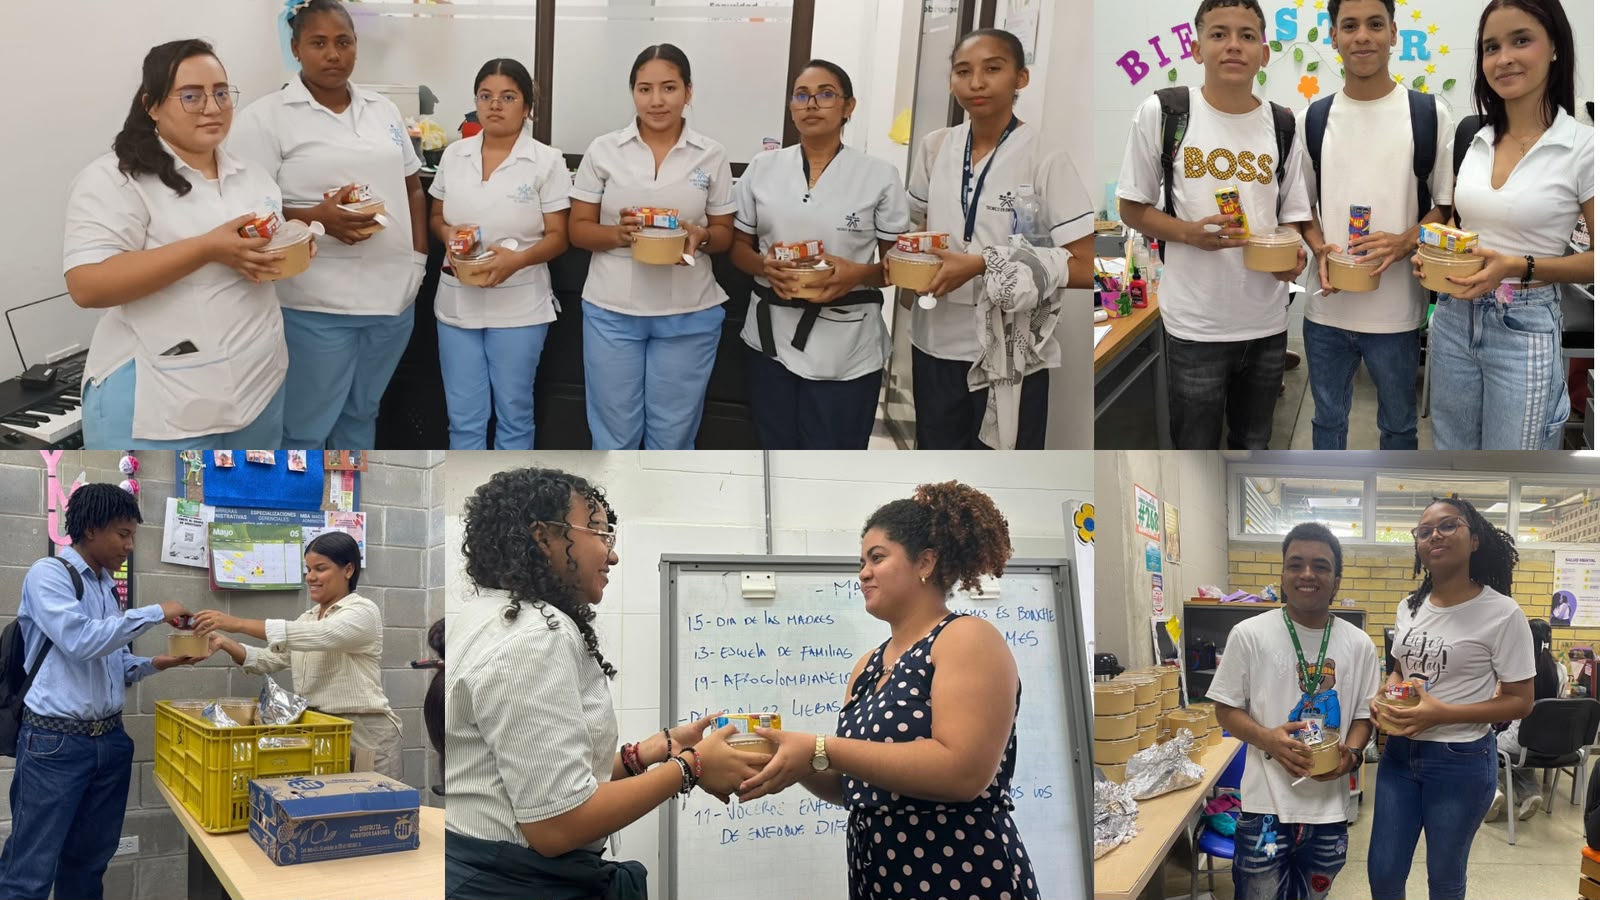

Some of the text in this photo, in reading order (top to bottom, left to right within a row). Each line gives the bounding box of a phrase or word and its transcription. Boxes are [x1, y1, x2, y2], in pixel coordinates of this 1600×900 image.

[1184, 147, 1273, 185] BOSS
[213, 528, 300, 538] Mayo 05
[716, 616, 737, 627] DIA
[744, 617, 758, 625] DE
[787, 614, 835, 626] MADRES
[996, 606, 1010, 620] ES
[1401, 626, 1454, 658] Enjoy
[778, 645, 792, 657] DE
[1401, 650, 1448, 685] today!
[720, 828, 740, 845] DE
